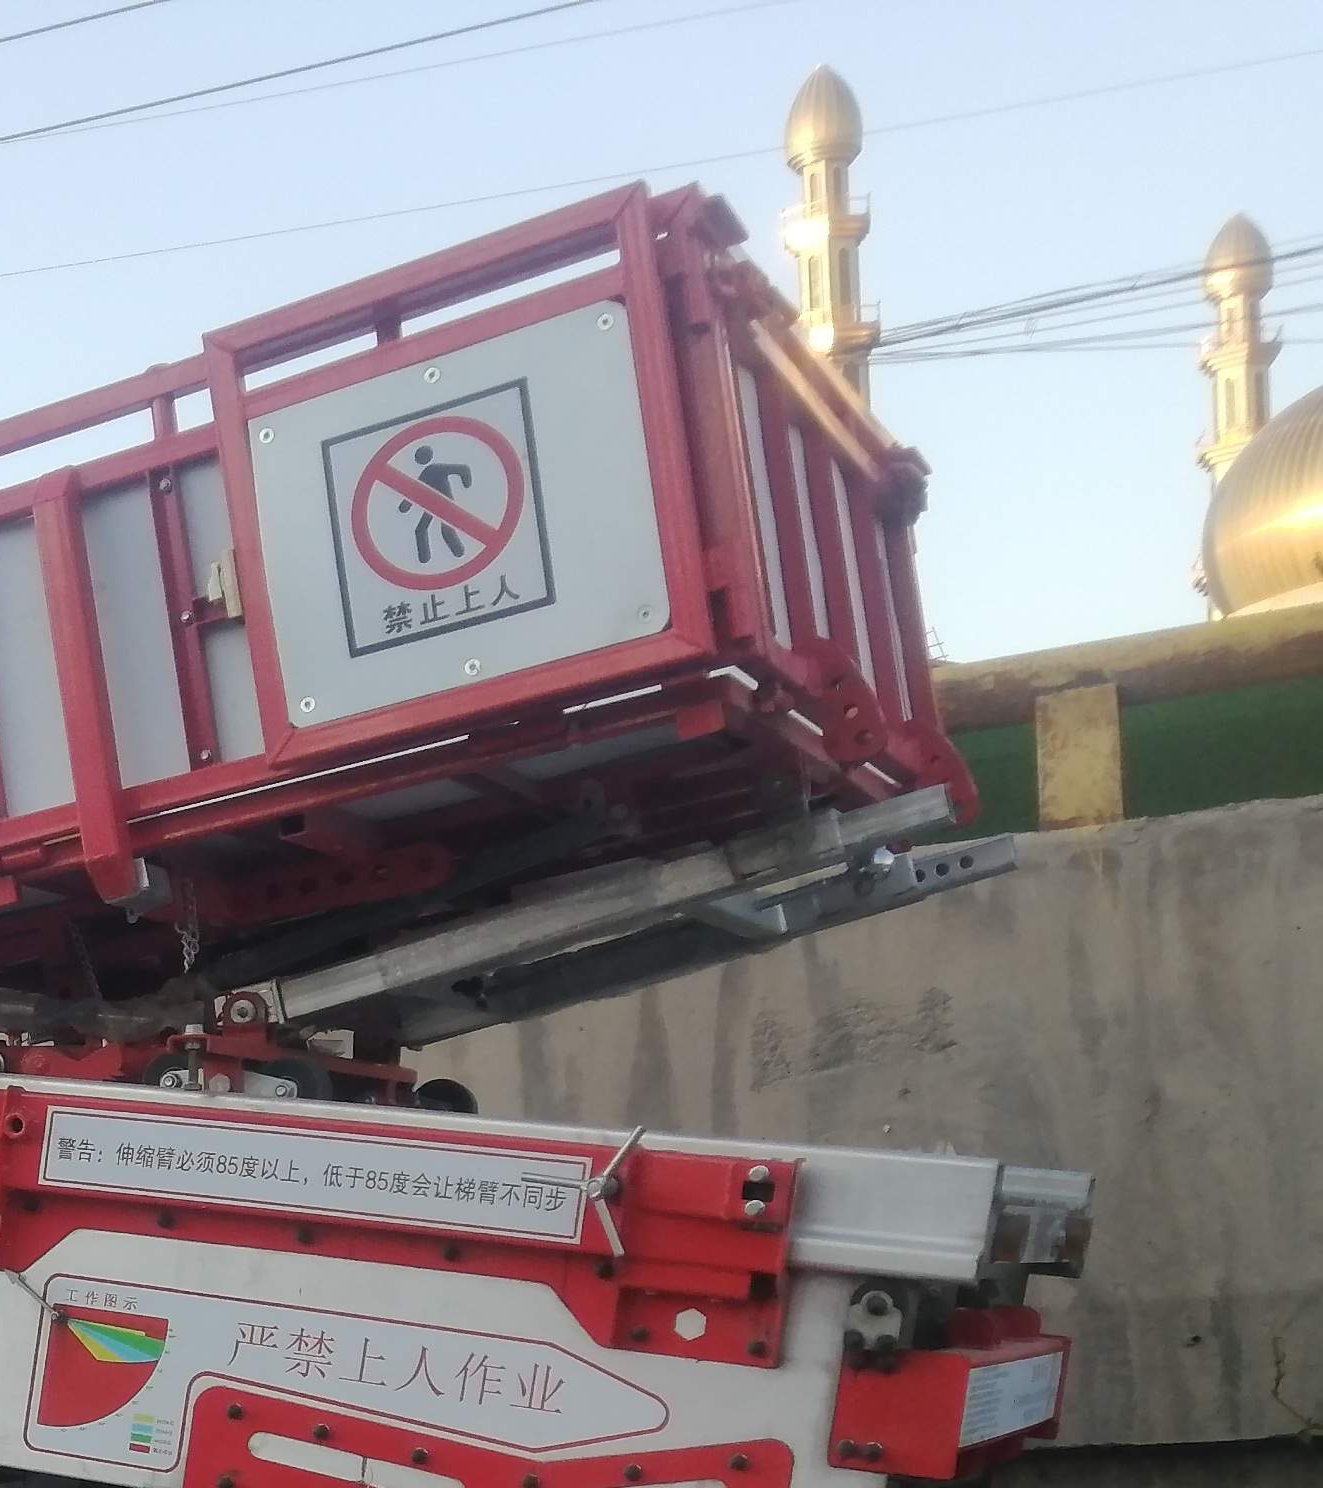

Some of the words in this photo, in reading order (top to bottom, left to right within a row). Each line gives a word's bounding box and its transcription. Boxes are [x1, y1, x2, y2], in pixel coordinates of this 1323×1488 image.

[383, 574, 520, 634] 禁止上人
[66, 1288, 138, 1311] 工作图示
[228, 1322, 567, 1414] 严禁上人作业
